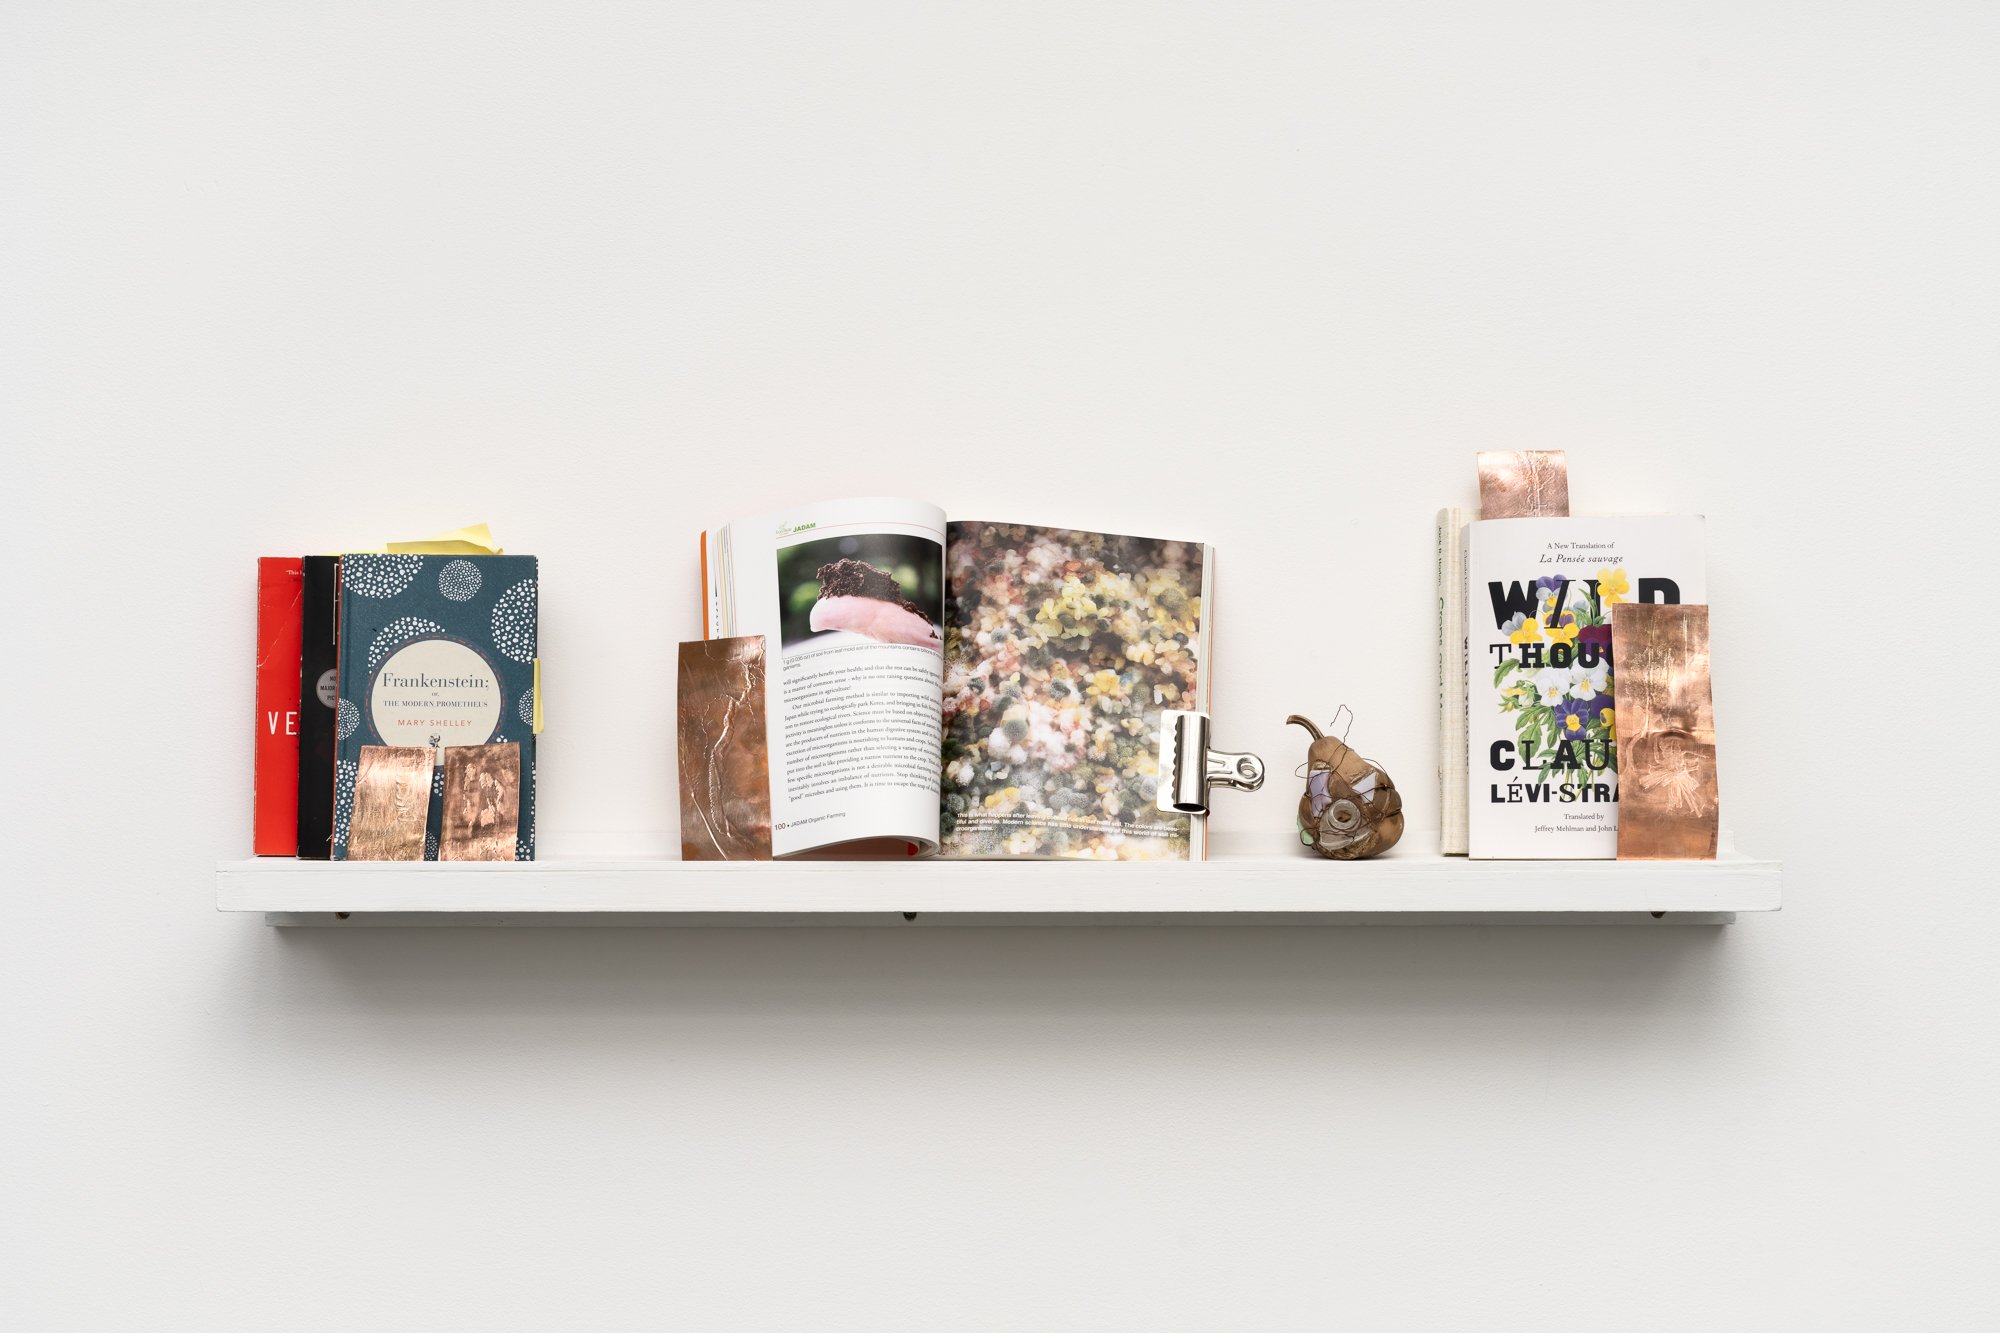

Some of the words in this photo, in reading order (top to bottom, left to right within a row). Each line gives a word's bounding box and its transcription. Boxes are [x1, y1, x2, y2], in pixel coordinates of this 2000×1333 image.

[793, 522, 816, 532] JADAM
[1539, 554, 1552, 563] La
[1556, 554, 1586, 562] Pensée
[1588, 556, 1624, 564] sauvage
[1489, 643, 1613, 668] THOU
[383, 673, 489, 691] Frankenstein;
[803, 698, 824, 708] microbial
[896, 692, 920, 700] importing
[830, 702, 856, 711] ecologically
[815, 714, 836, 722] ecological
[812, 740, 848, 750] microorganisms
[786, 757, 804, 766] number
[811, 750, 846, 760] microorganisms
[1490, 739, 1613, 771] CLAU
[836, 756, 860, 765] providing
[814, 768, 850, 778] microorganisms
[811, 779, 830, 788] involves
[838, 774, 862, 782] imbalance
[909, 772, 928, 781] thinking
[805, 789, 825, 798] microbes
[775, 822, 786, 830] 100
[790, 819, 808, 827] JADAM
[808, 815, 826, 823] Organic
[1597, 813, 1604, 822] by
[1072, 824, 1113, 834] understanding
[1534, 825, 1554, 833] Jeffrey
[1598, 825, 1612, 833] John
